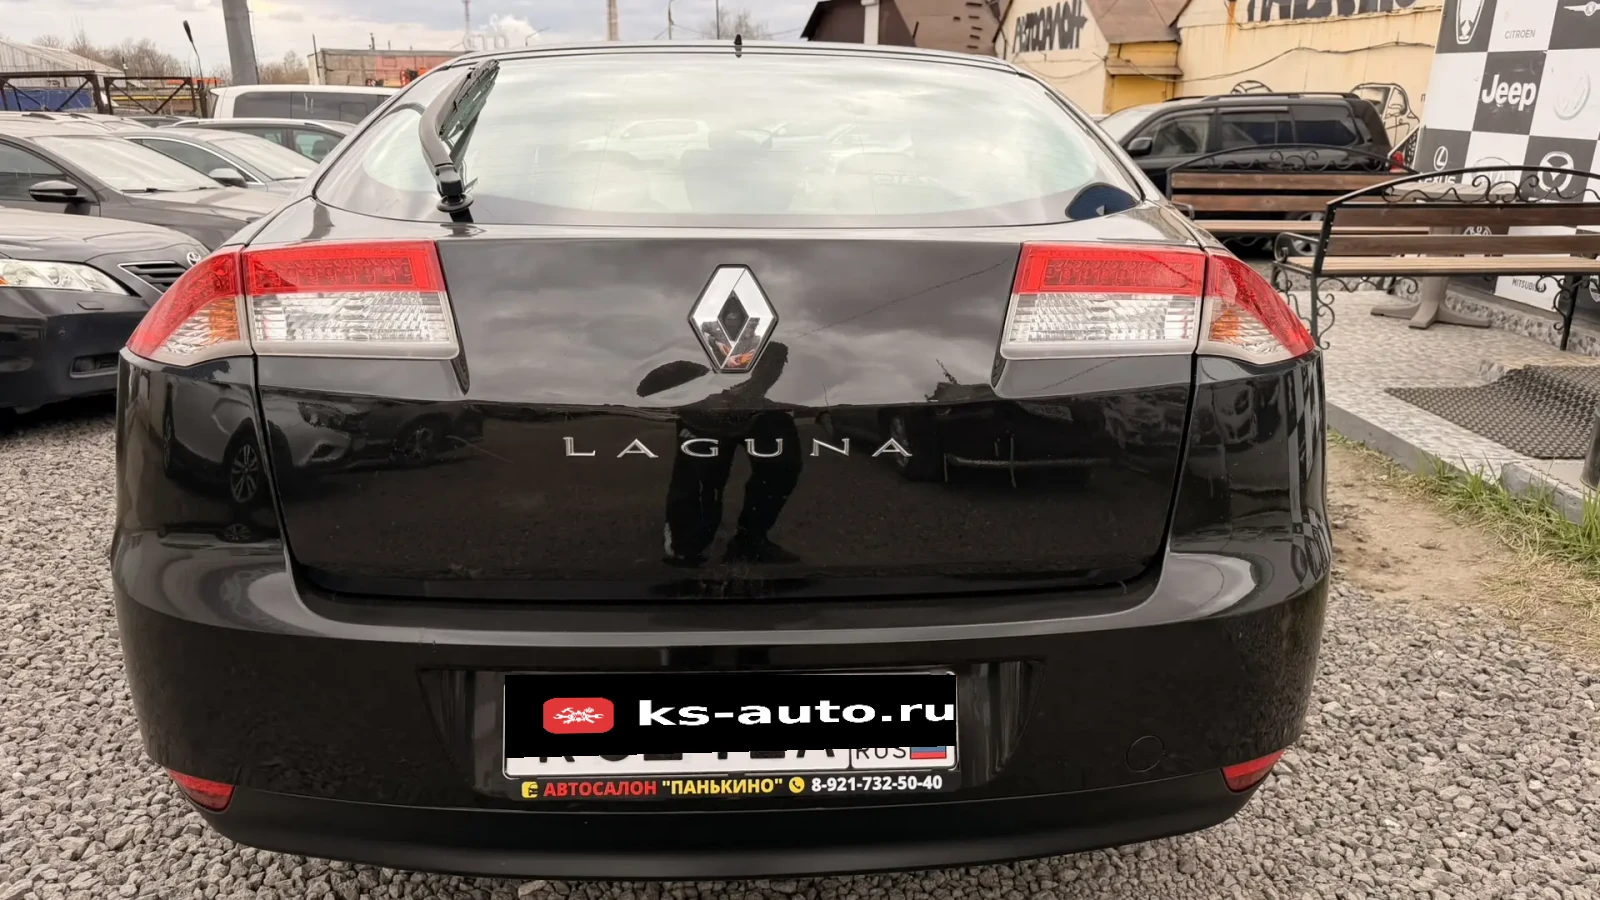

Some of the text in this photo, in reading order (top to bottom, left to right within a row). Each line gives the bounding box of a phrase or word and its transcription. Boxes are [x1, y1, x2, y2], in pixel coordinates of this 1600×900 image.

[1481, 74, 1537, 111] Jeep
[1511, 277, 1545, 293] MITSUBI
[562, 436, 913, 458] LAGUNA
[543, 774, 943, 797] АВТОСАЛОН "ПАНЬКИНО" 8-921-732-50-40
